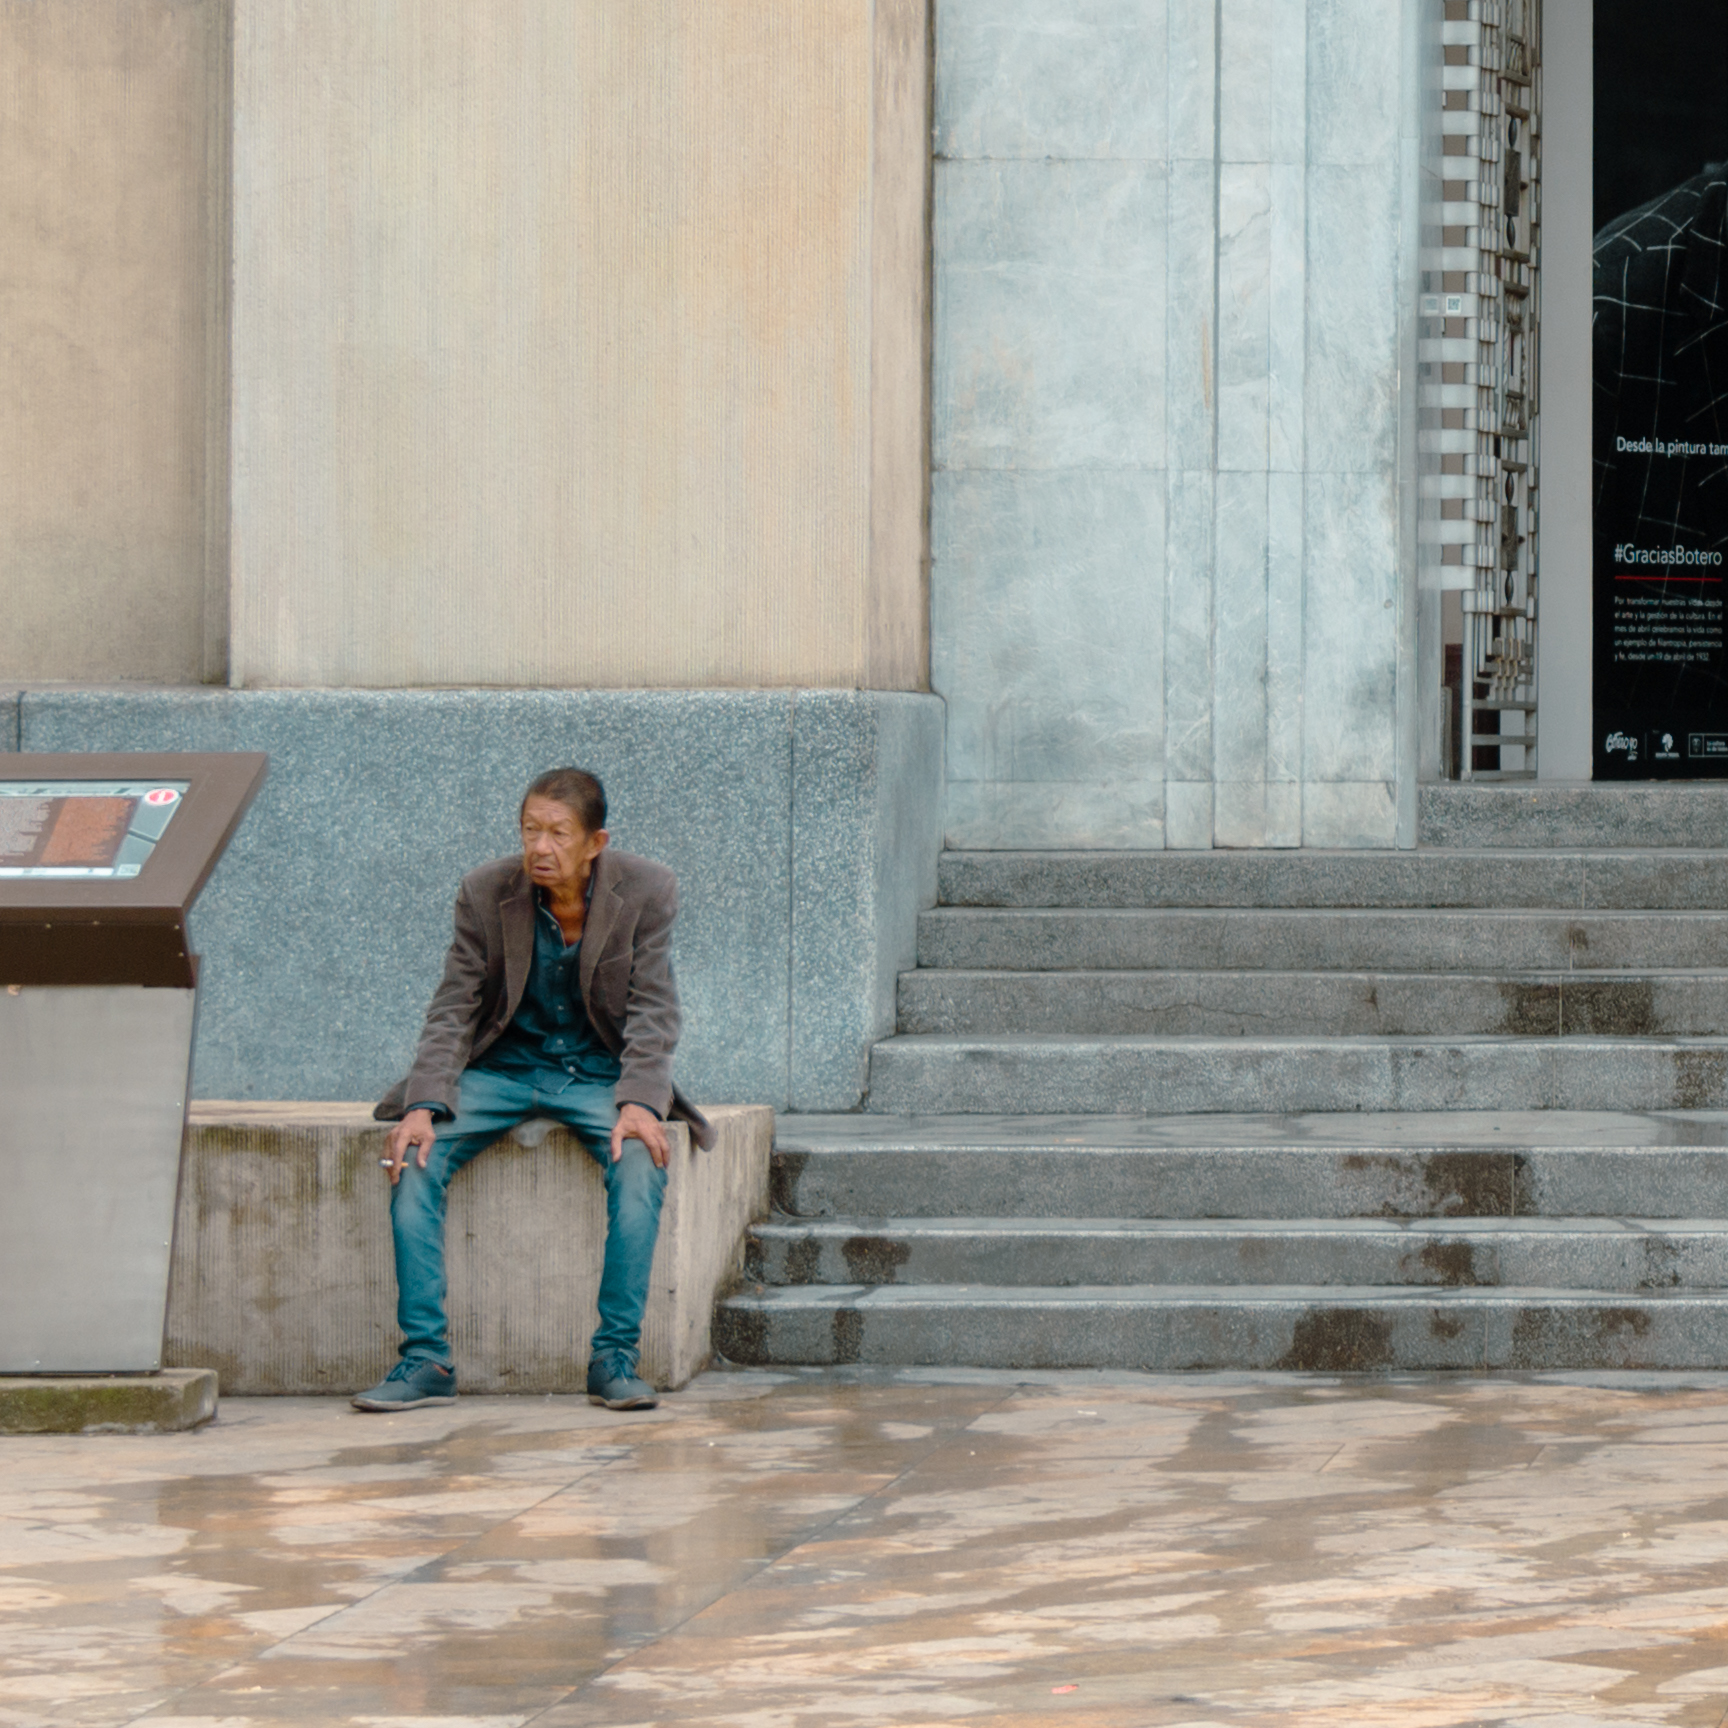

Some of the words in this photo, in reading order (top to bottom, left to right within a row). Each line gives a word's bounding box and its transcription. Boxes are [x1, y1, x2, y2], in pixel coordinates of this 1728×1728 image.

[1616, 436, 1653, 453] Desde
[1655, 437, 1665, 453] la
[1667, 438, 1707, 459] pintura
[1614, 542, 1723, 566] #GraciasBotero
